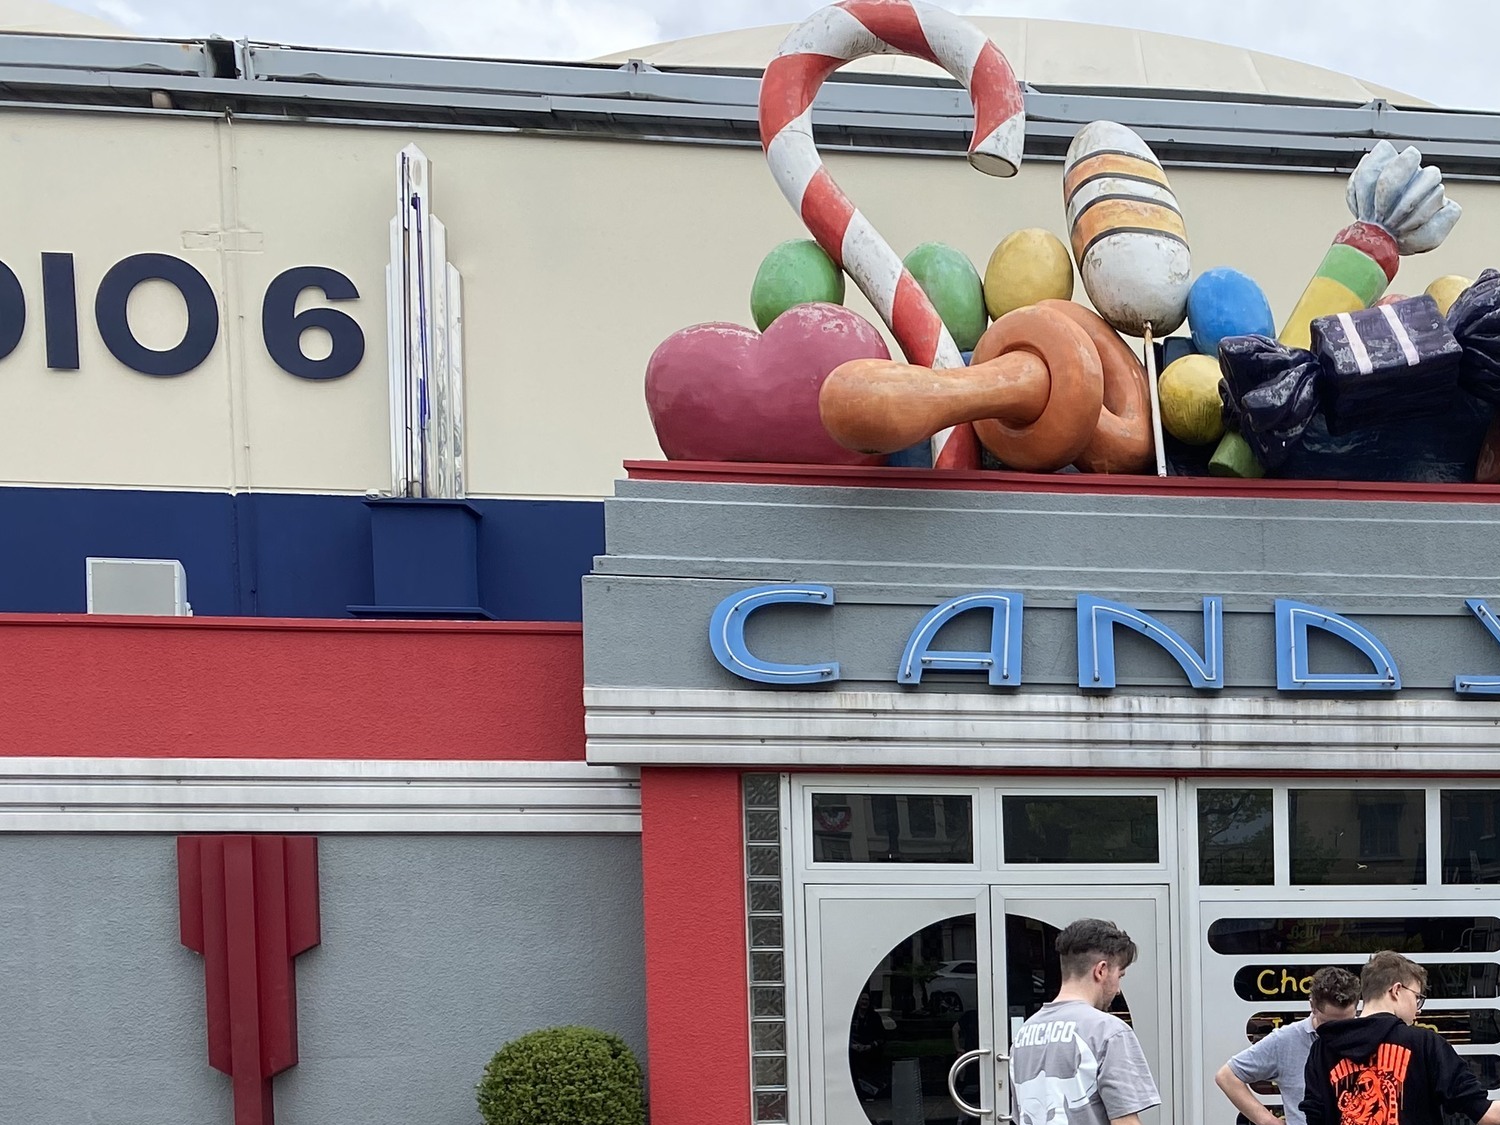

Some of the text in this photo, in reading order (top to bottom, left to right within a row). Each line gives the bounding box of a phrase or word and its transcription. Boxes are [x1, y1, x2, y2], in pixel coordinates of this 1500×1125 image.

[0, 252, 365, 380] IO 6
[1014, 1021, 1077, 1048] CHICAGO
